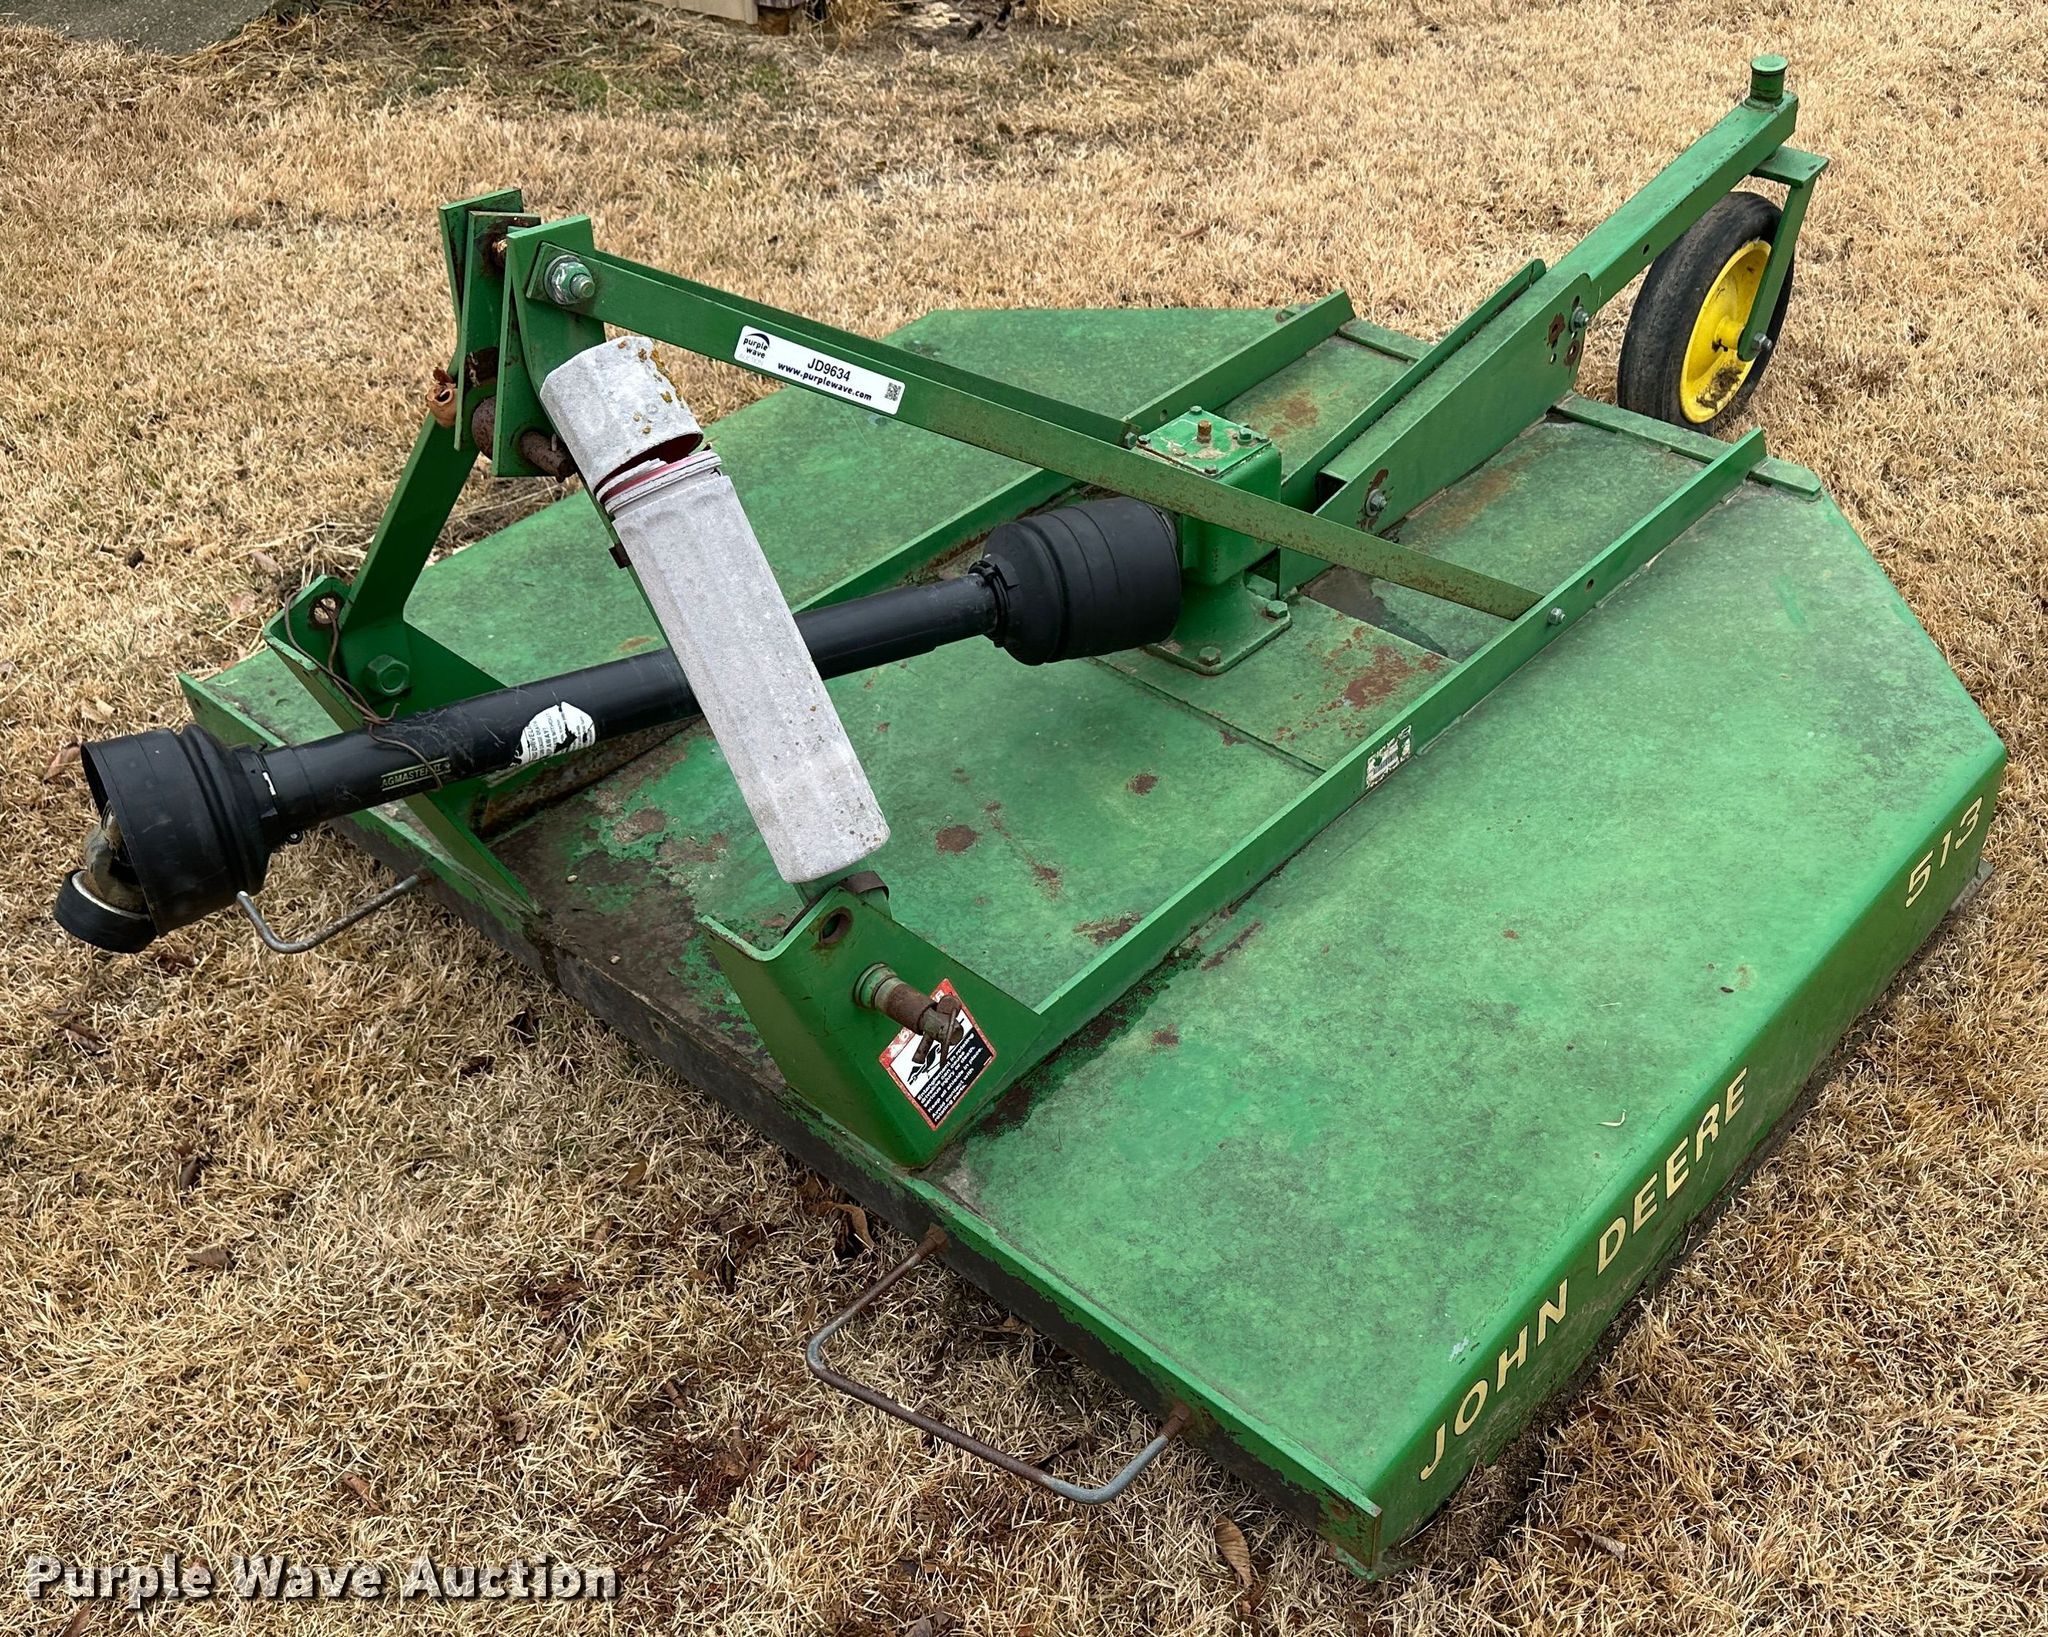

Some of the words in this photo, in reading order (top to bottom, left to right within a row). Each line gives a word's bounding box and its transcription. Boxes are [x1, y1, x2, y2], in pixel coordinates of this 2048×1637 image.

[743, 336, 768, 351] purple
[746, 347, 766, 359] wave
[777, 362, 872, 401] www.purplewave.com
[807, 358, 851, 382] JD9634
[1904, 795, 1983, 908] 513
[1419, 1278, 1569, 1482] JOHN
[1596, 1066, 1749, 1276] DEERE
